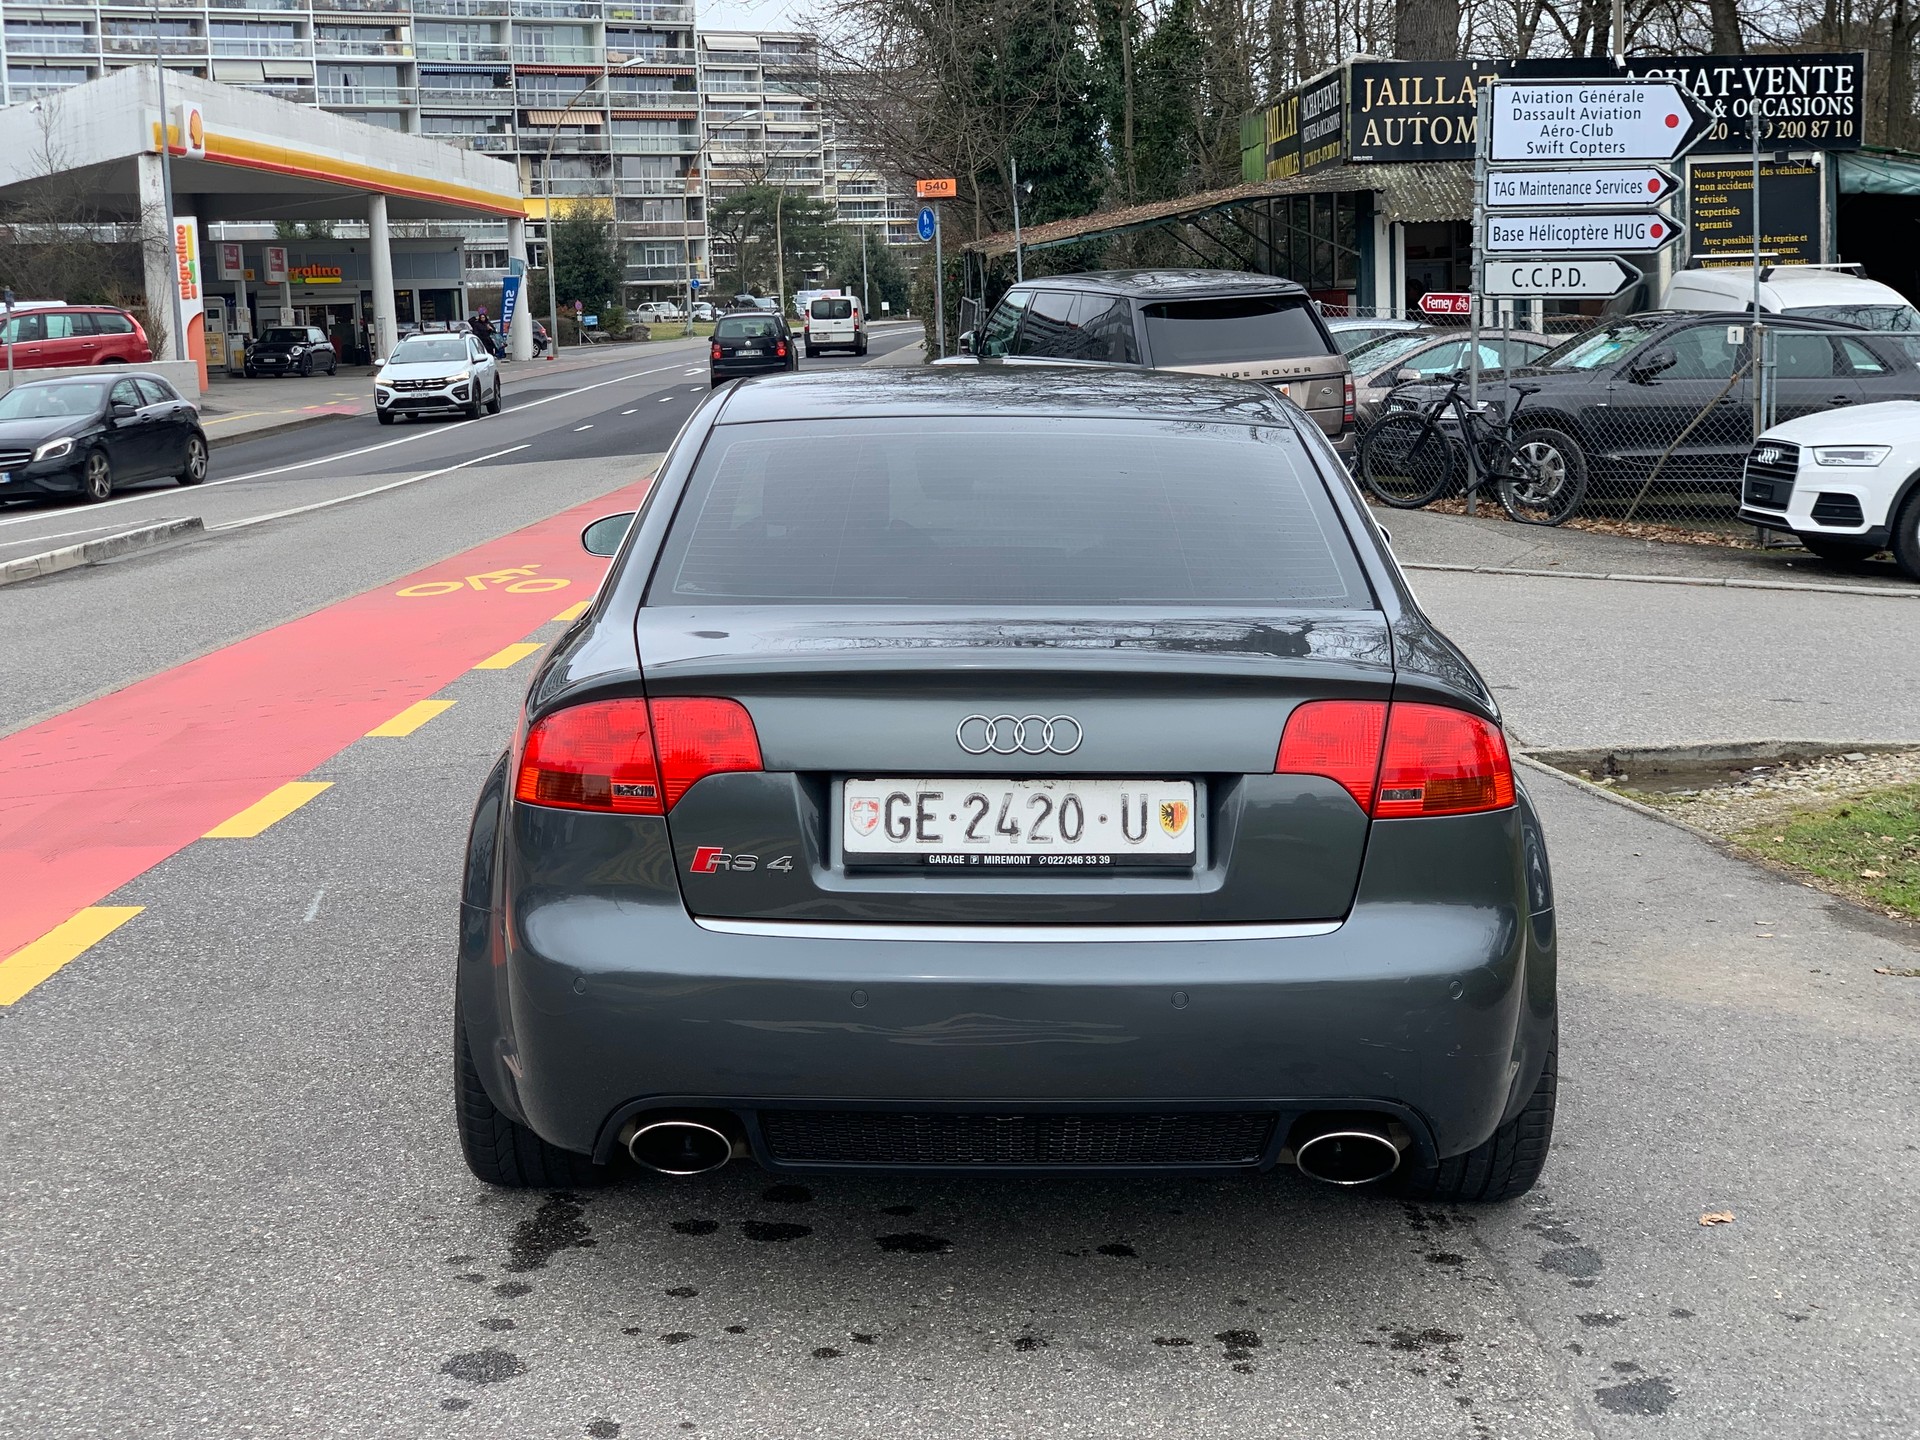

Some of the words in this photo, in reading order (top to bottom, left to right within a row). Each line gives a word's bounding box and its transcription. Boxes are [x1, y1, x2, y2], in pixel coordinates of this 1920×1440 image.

[1626, 66, 1854, 97] HAT-VENTE
[1511, 91, 1573, 104] Aviation
[1579, 89, 1645, 104] Générale
[1513, 107, 1576, 121] Dassault
[1580, 107, 1641, 120] Aviation
[1733, 96, 1854, 118] OCCASIONS
[1265, 96, 1299, 156] JAILLAT
[1361, 116, 1477, 147] AUTOM
[1540, 123, 1614, 138] Aéro-Club
[1777, 120, 1806, 139] 200
[1811, 120, 1830, 138] 87
[1835, 119, 1854, 138] 10
[1526, 141, 1564, 155] Swift
[1569, 141, 1626, 157] Copters
[1694, 169, 1715, 179] Nous
[1717, 170, 1755, 180] proposon
[1760, 167, 1774, 176] des
[925, 181, 948, 191] 540
[1494, 181, 1516, 197] TAG
[1519, 180, 1592, 197] Maintenance
[1595, 179, 1643, 194] Services
[1700, 208, 1741, 218] expertisés
[1700, 219, 1733, 231] garantis
[1493, 226, 1524, 242] Base
[1529, 224, 1609, 245] Hélicoptère
[1614, 223, 1645, 240] HUG
[1702, 237, 1721, 246] Avec
[1723, 235, 1761, 246] possibili
[1763, 235, 1772, 243] de
[1773, 234, 1798, 245] reprise
[1800, 233, 1808, 242] et
[176, 224, 193, 300] migrolino
[1511, 267, 1586, 288] C.C.P.D.
[1426, 296, 1453, 313] Ferney
[1732, 330, 1738, 341] 1
[1261, 366, 1312, 376] ROVER
[883, 790, 943, 845] GE
[962, 791, 1086, 845] 2420
[1120, 792, 1150, 845] U
[705, 852, 760, 873] RS
[766, 854, 794, 873] 4
[928, 854, 966, 866] GARAGE
[983, 854, 1032, 866] MIREMONT
[1047, 854, 1084, 866] 022/346
[1085, 854, 1098, 866] 33
[1098, 854, 1111, 866] 39
